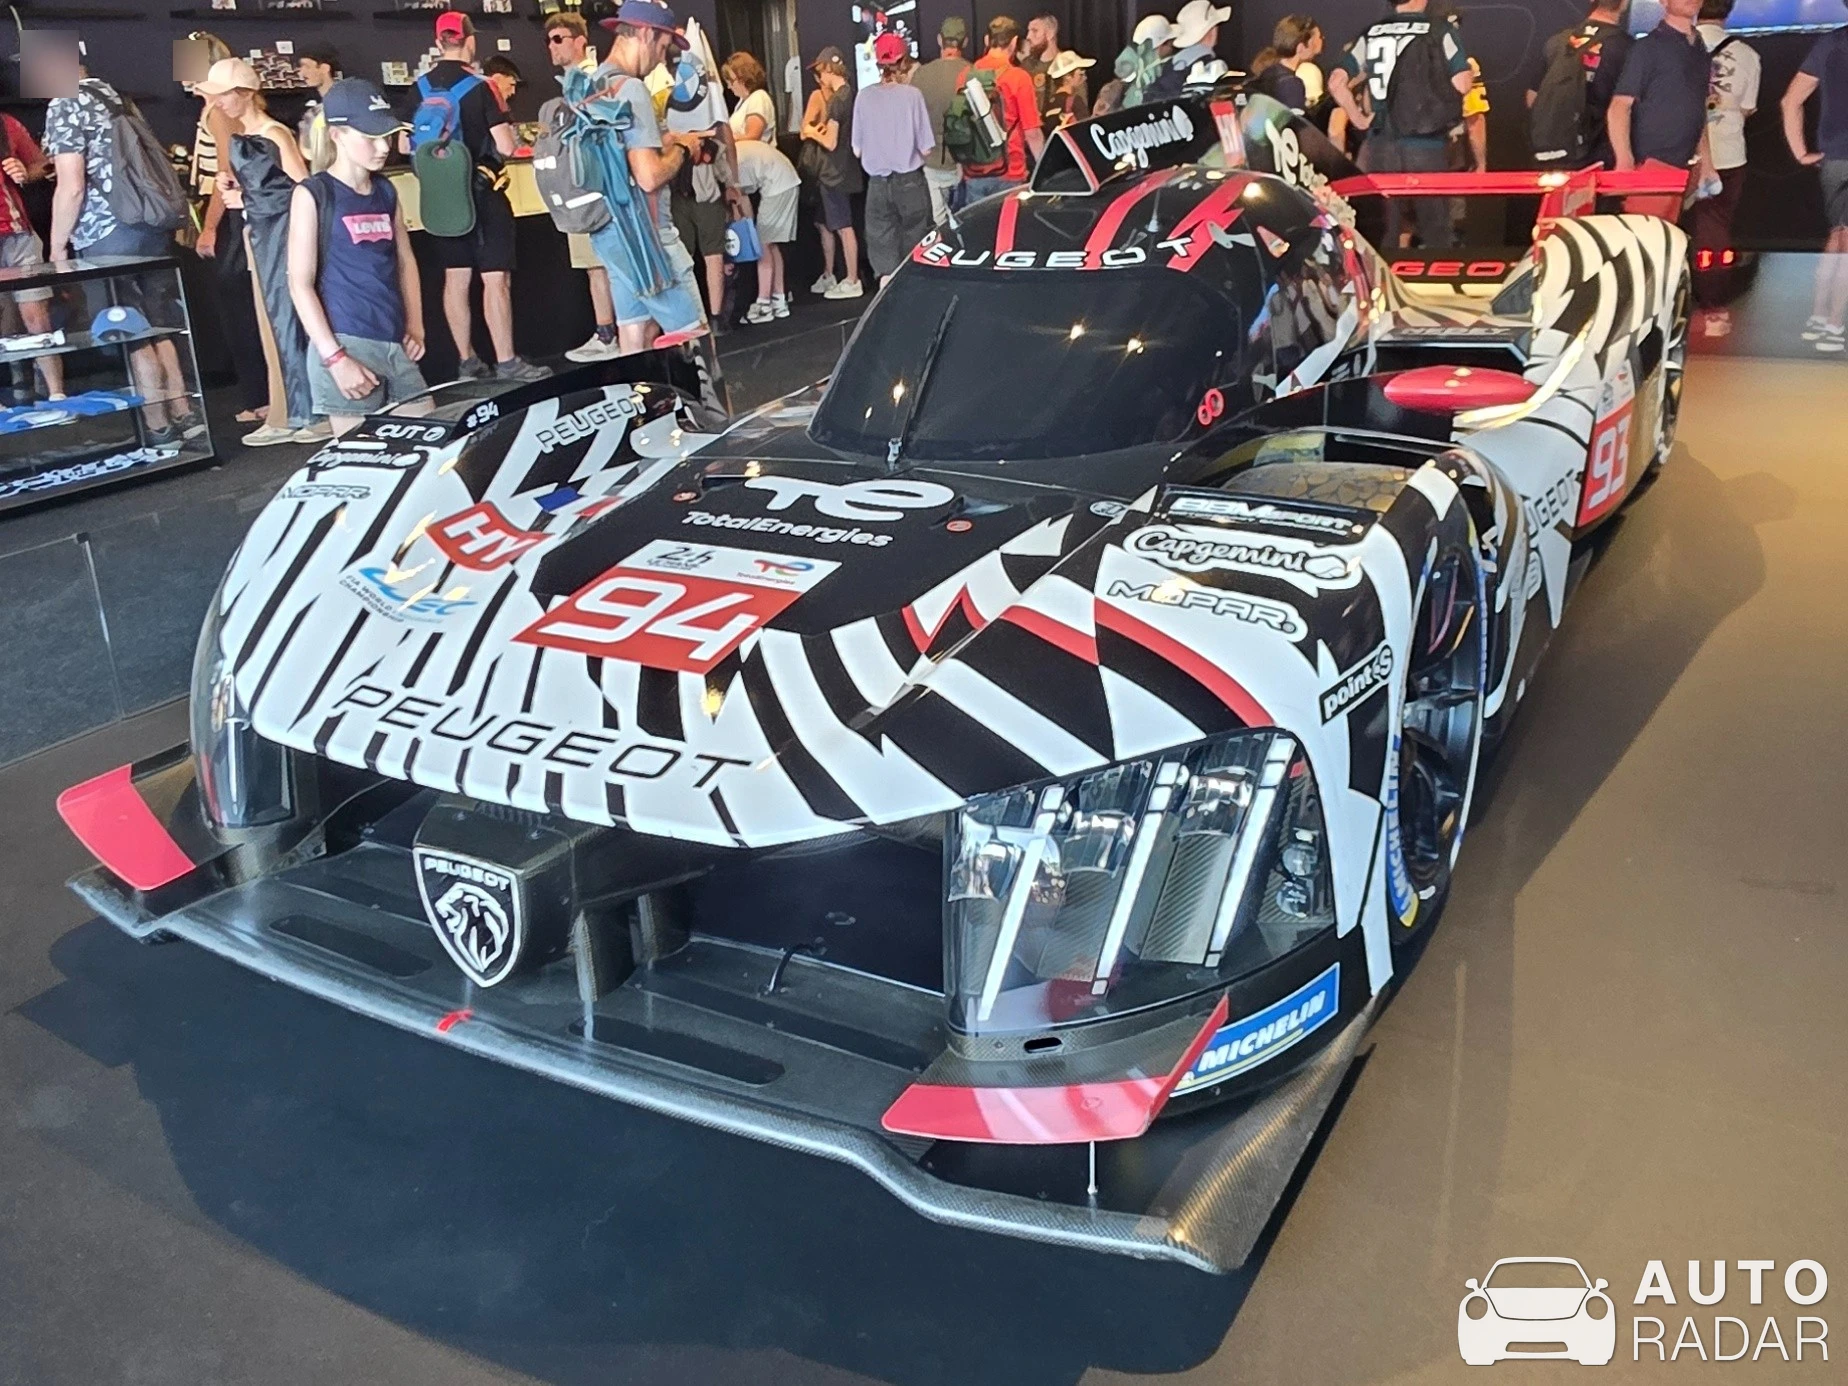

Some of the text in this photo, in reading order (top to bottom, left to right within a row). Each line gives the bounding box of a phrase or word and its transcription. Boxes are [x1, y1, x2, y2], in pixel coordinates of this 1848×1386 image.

[921, 230, 1193, 268] PEUGEOT
[536, 392, 646, 450] PEUGEOT
[1589, 413, 1632, 510] 93
[443, 511, 539, 564] HY
[682, 510, 894, 548] TotalEnergies
[1135, 530, 1305, 571] Capgemini
[536, 576, 759, 661] 94
[1106, 580, 1290, 632] MOPAR
[332, 684, 752, 788] PEUGEOT
[424, 857, 510, 891] PEUGEOT
[1197, 990, 1326, 1072] MICHELIN
